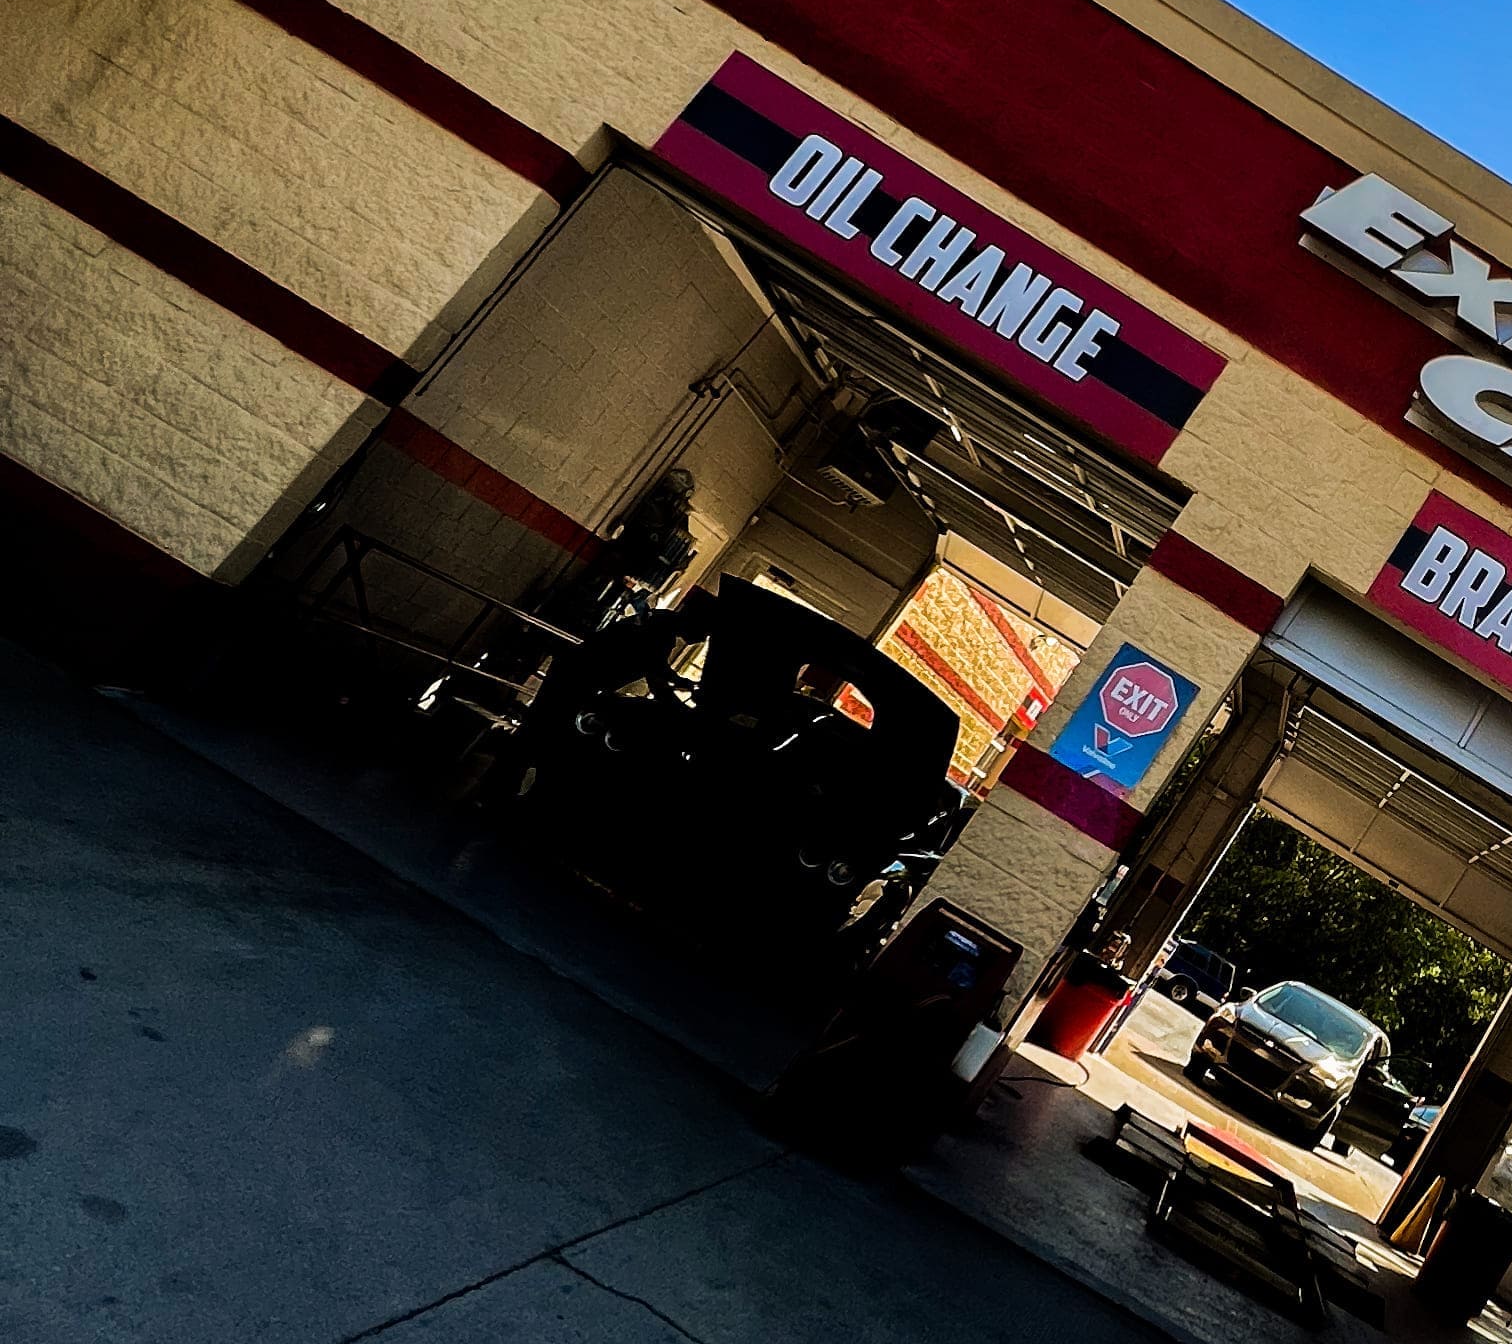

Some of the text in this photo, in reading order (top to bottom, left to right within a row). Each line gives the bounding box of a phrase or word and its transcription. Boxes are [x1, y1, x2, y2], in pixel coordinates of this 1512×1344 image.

[768, 134, 1120, 382] OIL CHANGE
[1110, 676, 1169, 721] EXIT
[1118, 707, 1140, 723] ONLY
